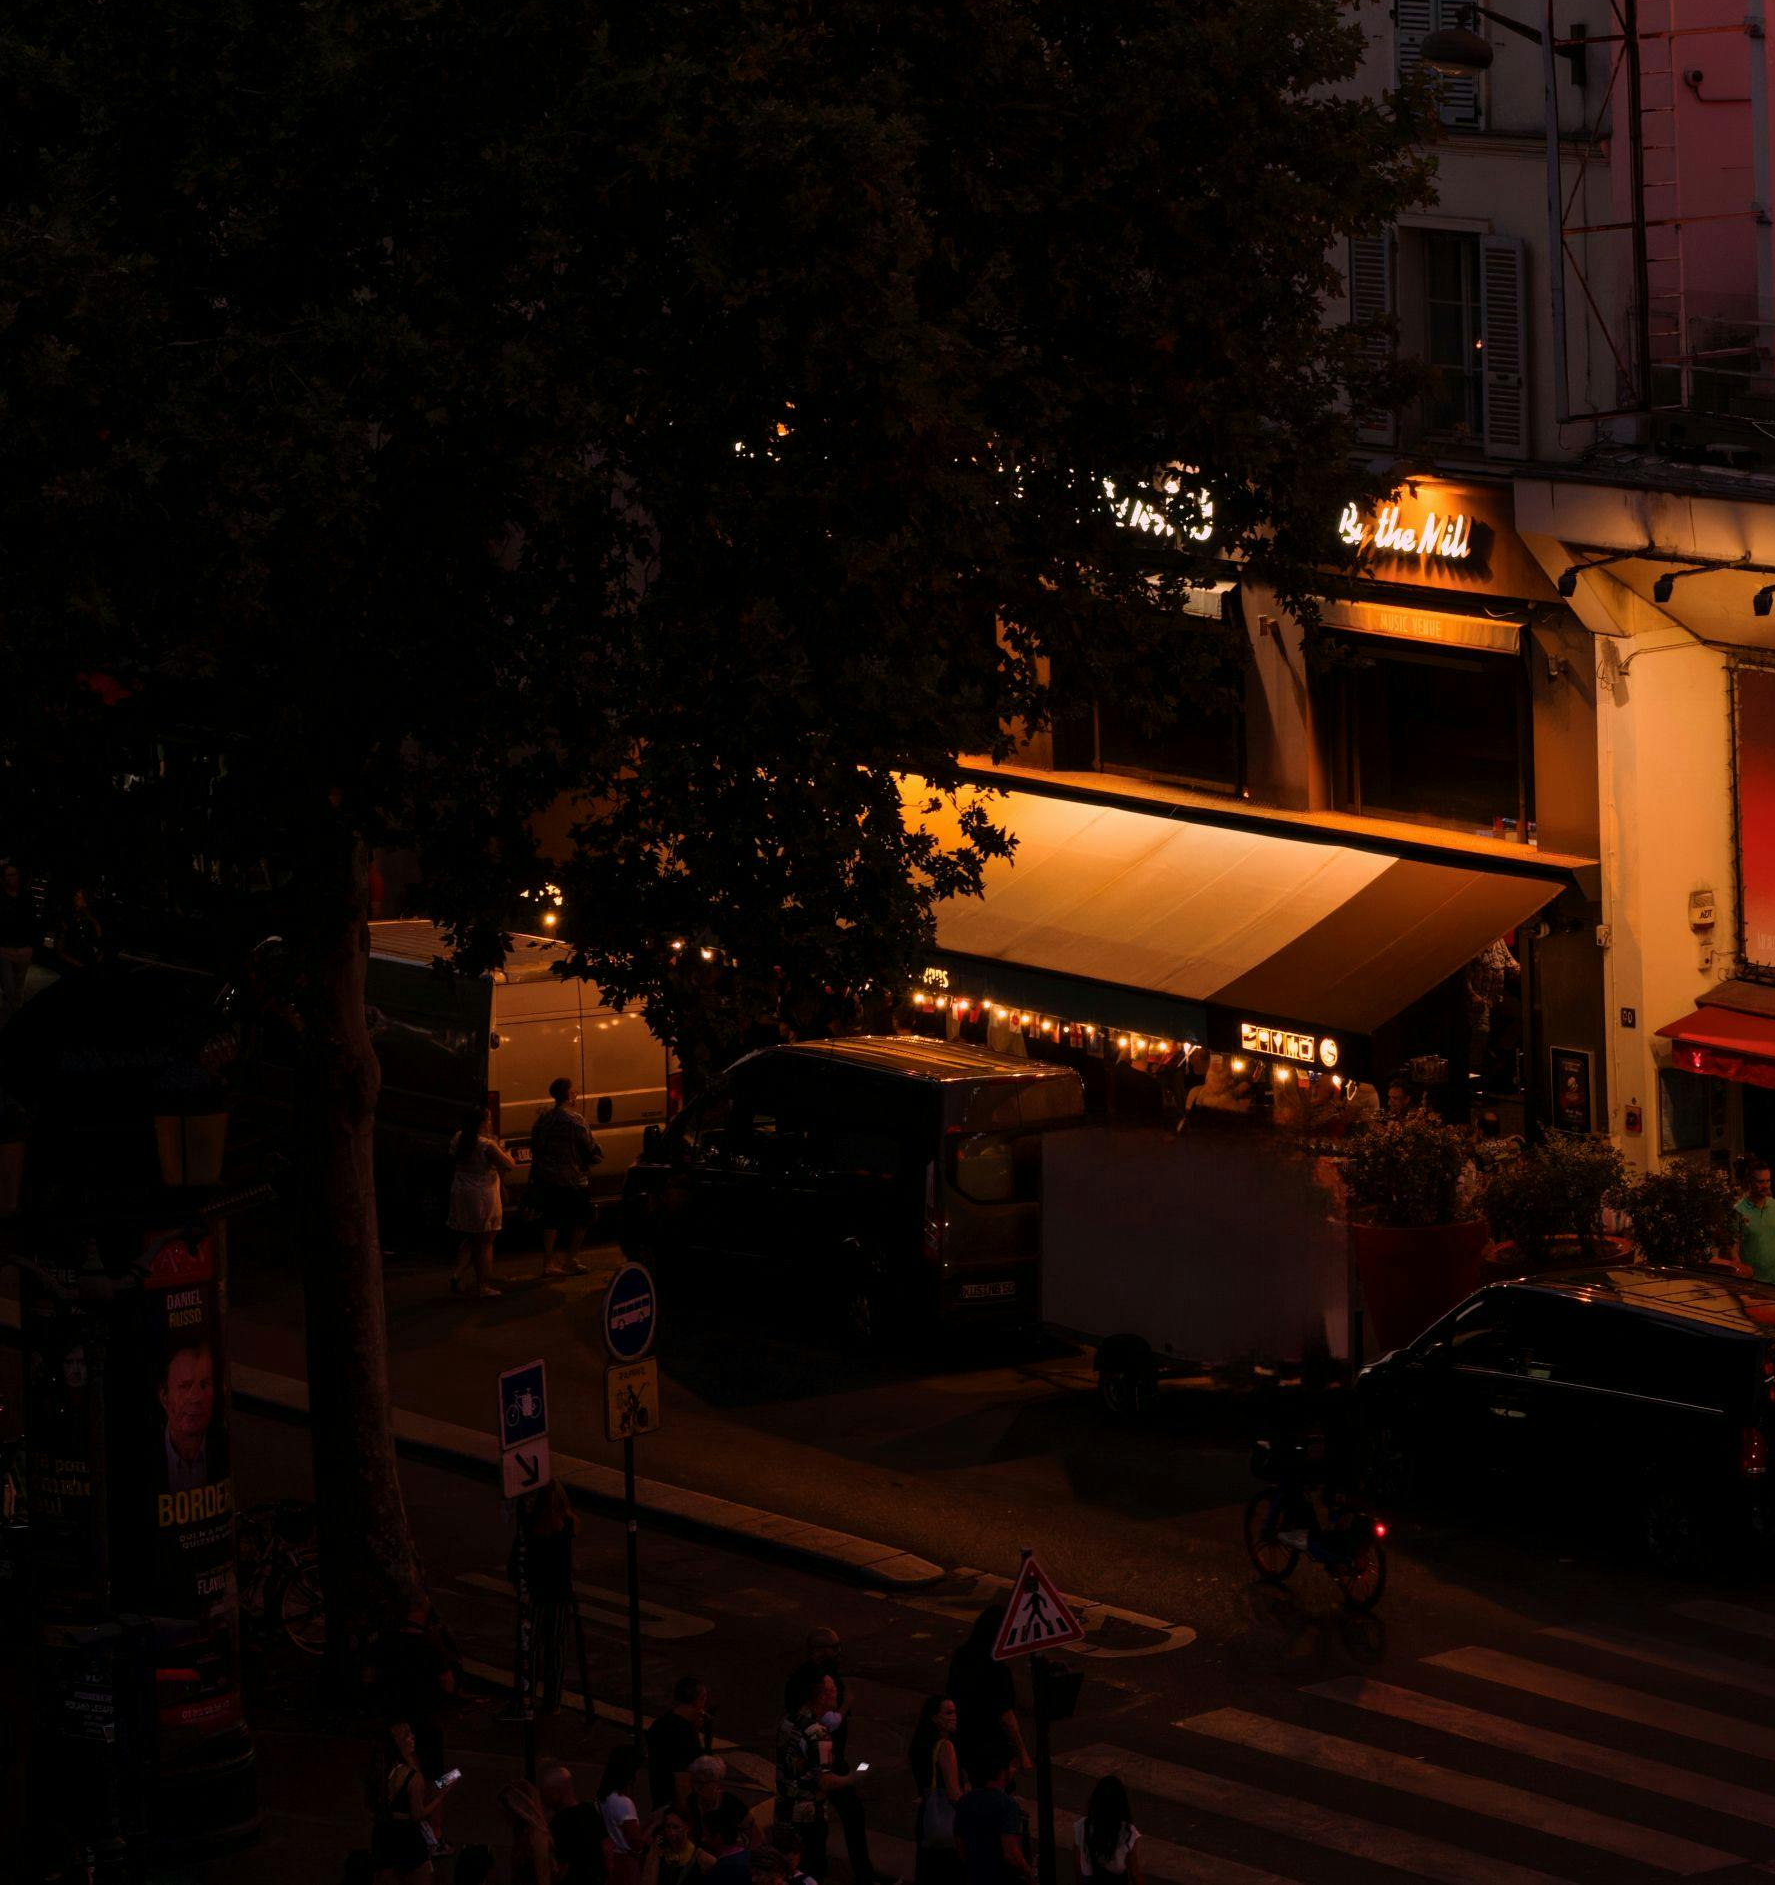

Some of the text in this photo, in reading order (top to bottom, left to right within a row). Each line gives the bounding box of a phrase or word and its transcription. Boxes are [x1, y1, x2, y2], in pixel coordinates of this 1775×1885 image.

[1339, 502, 1472, 557] By the Mill
[1381, 613, 1440, 637] MUSIC VENUE
[166, 1288, 202, 1310] DANIEL
